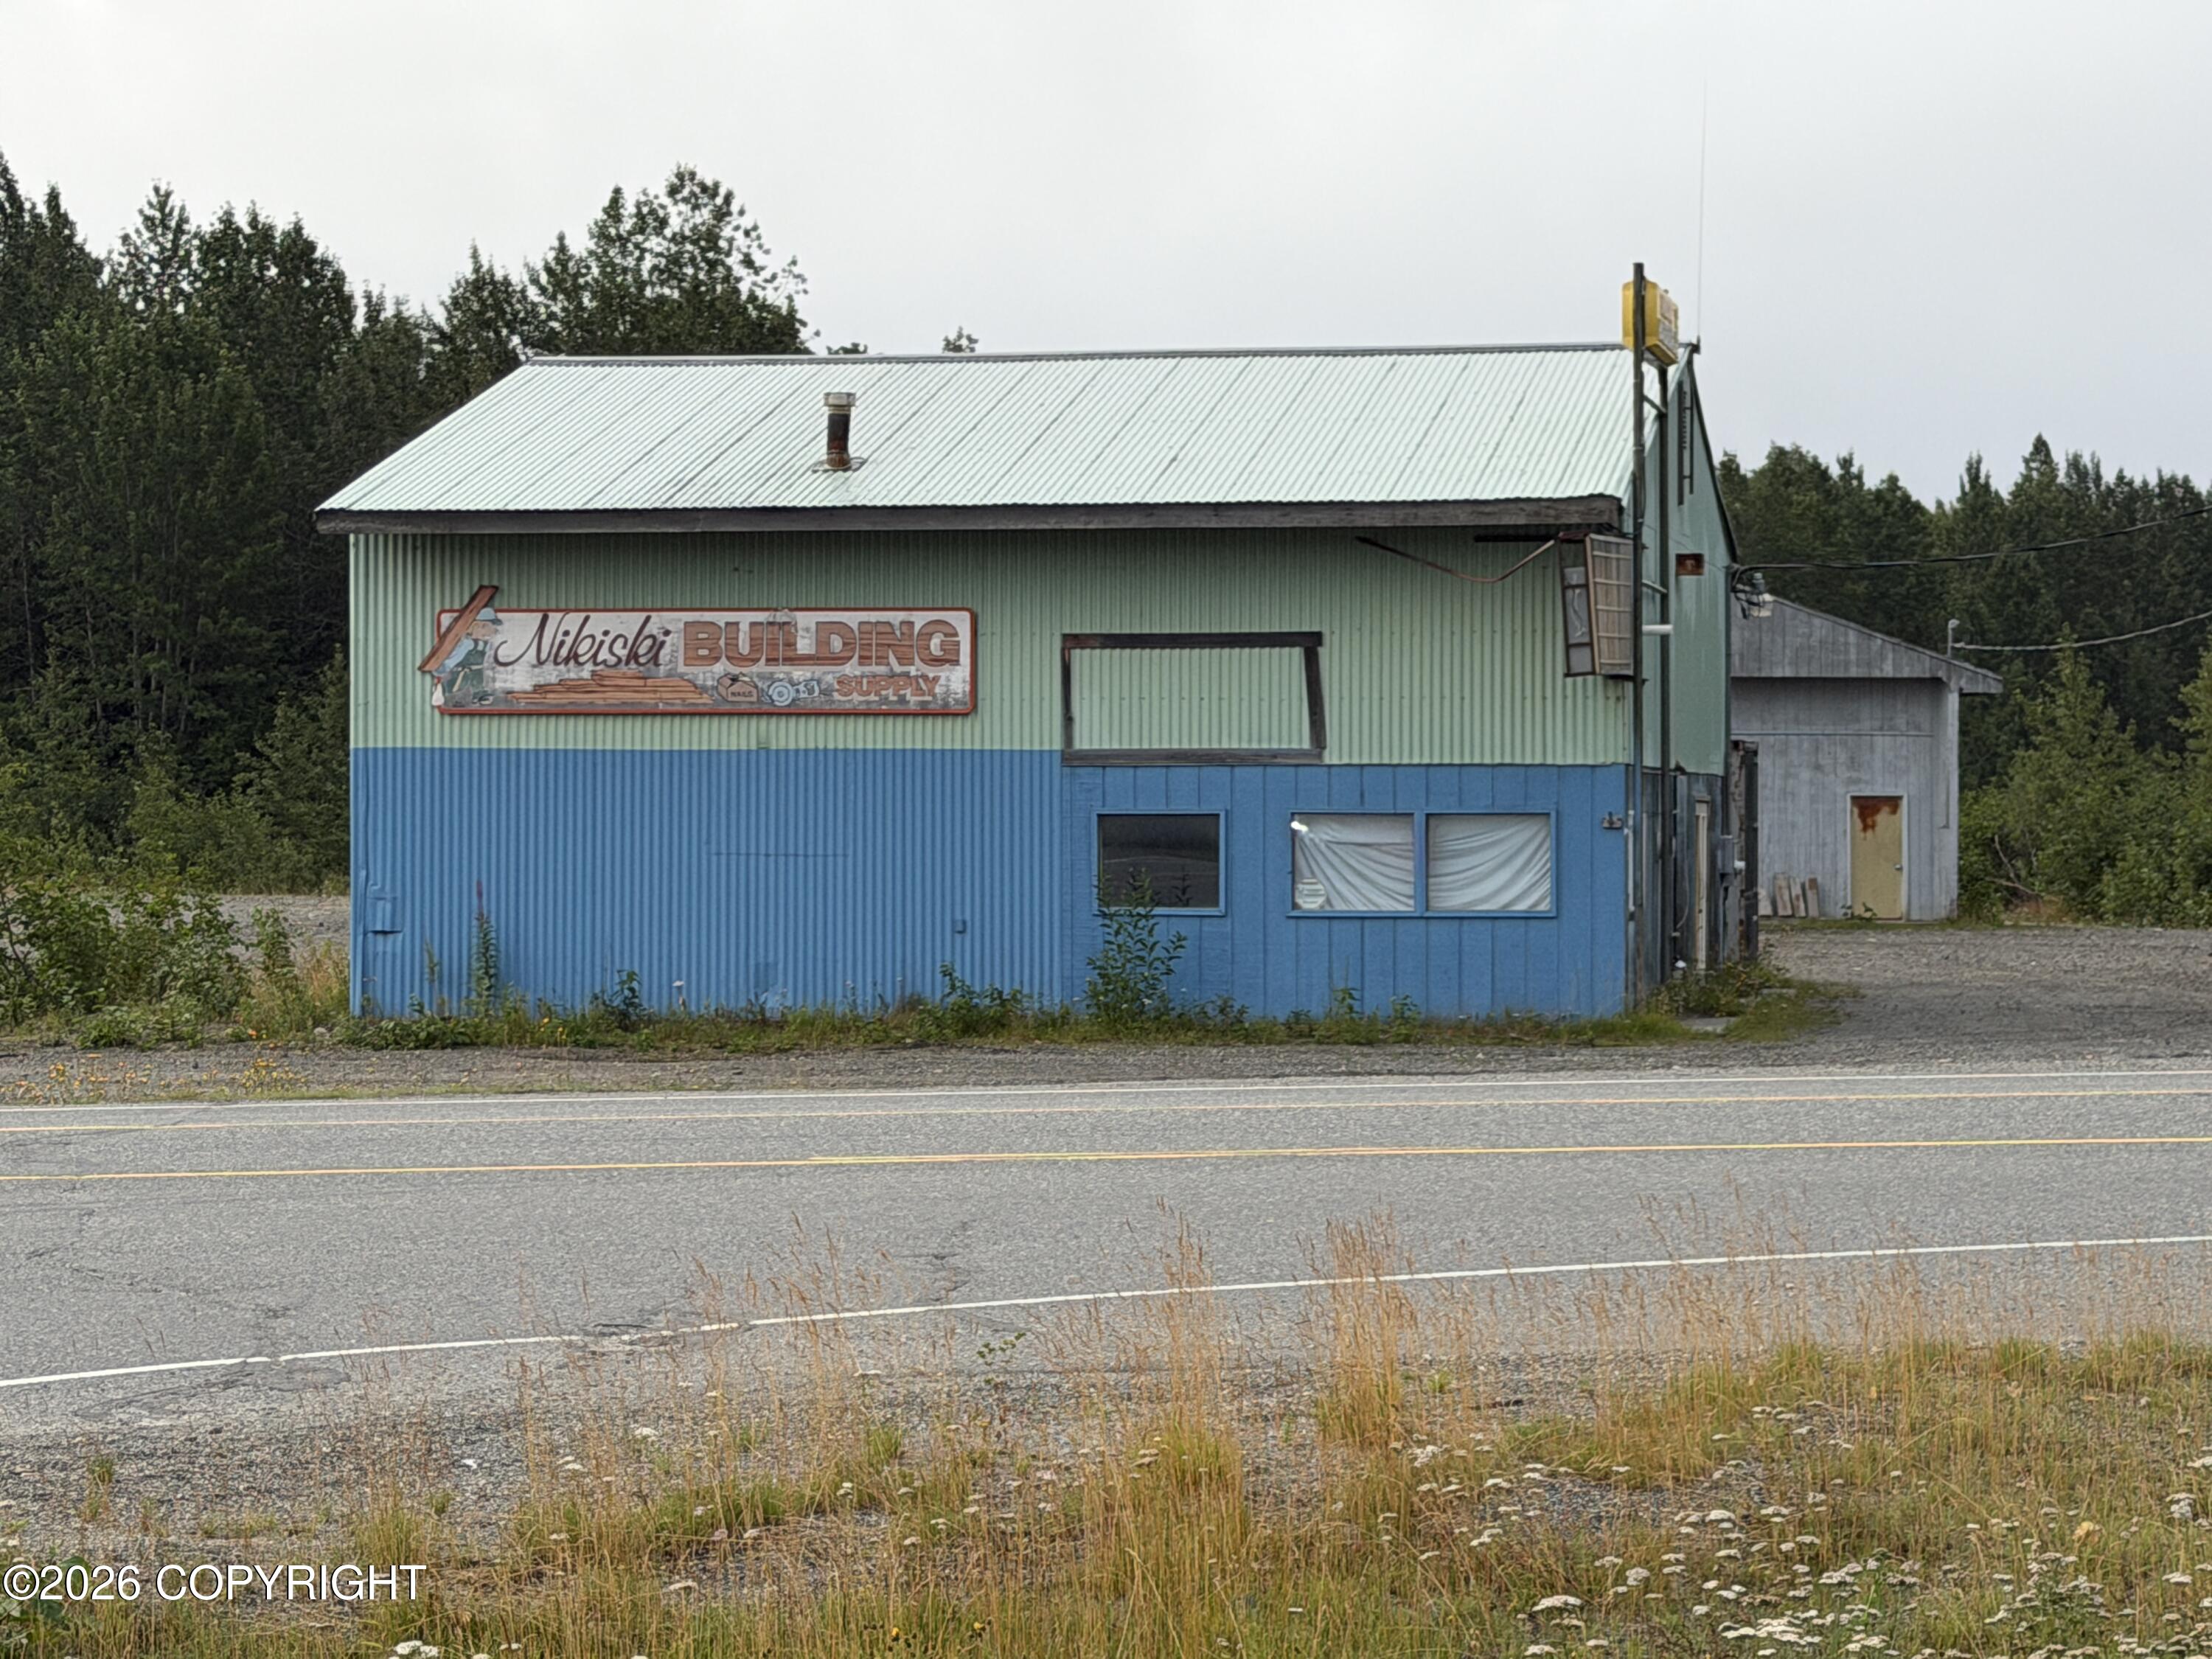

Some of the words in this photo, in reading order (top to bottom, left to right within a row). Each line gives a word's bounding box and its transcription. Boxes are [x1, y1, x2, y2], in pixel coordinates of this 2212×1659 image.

[493, 611, 672, 667] Nikiski
[684, 619, 961, 667] BUILDING
[836, 674, 942, 698] SUPPLY
